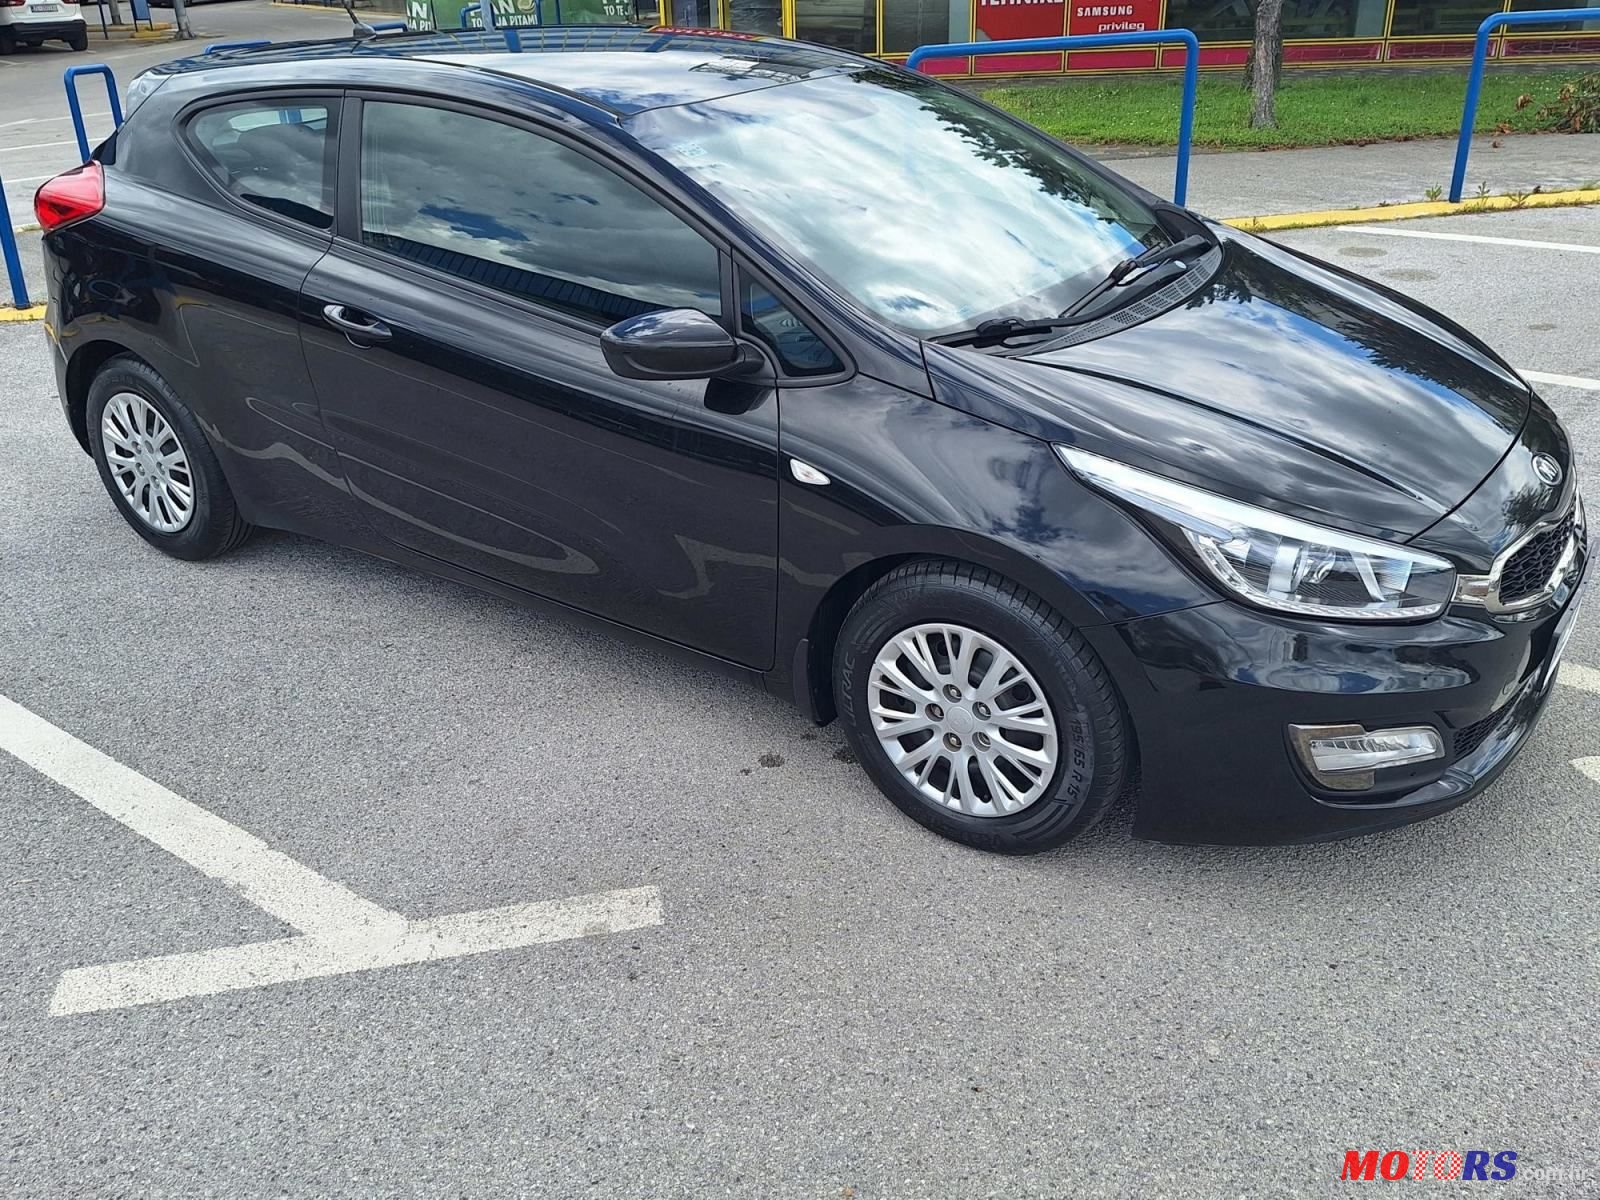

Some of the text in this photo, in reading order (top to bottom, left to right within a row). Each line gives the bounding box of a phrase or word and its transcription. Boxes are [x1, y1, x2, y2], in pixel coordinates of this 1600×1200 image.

[1077, 5, 1133, 17] SAMSUNG
[1098, 21, 1145, 33] privileg
[1069, 719, 1085, 768] 195/65
[1071, 770, 1083, 783] R
[1067, 784, 1081, 799] 15
